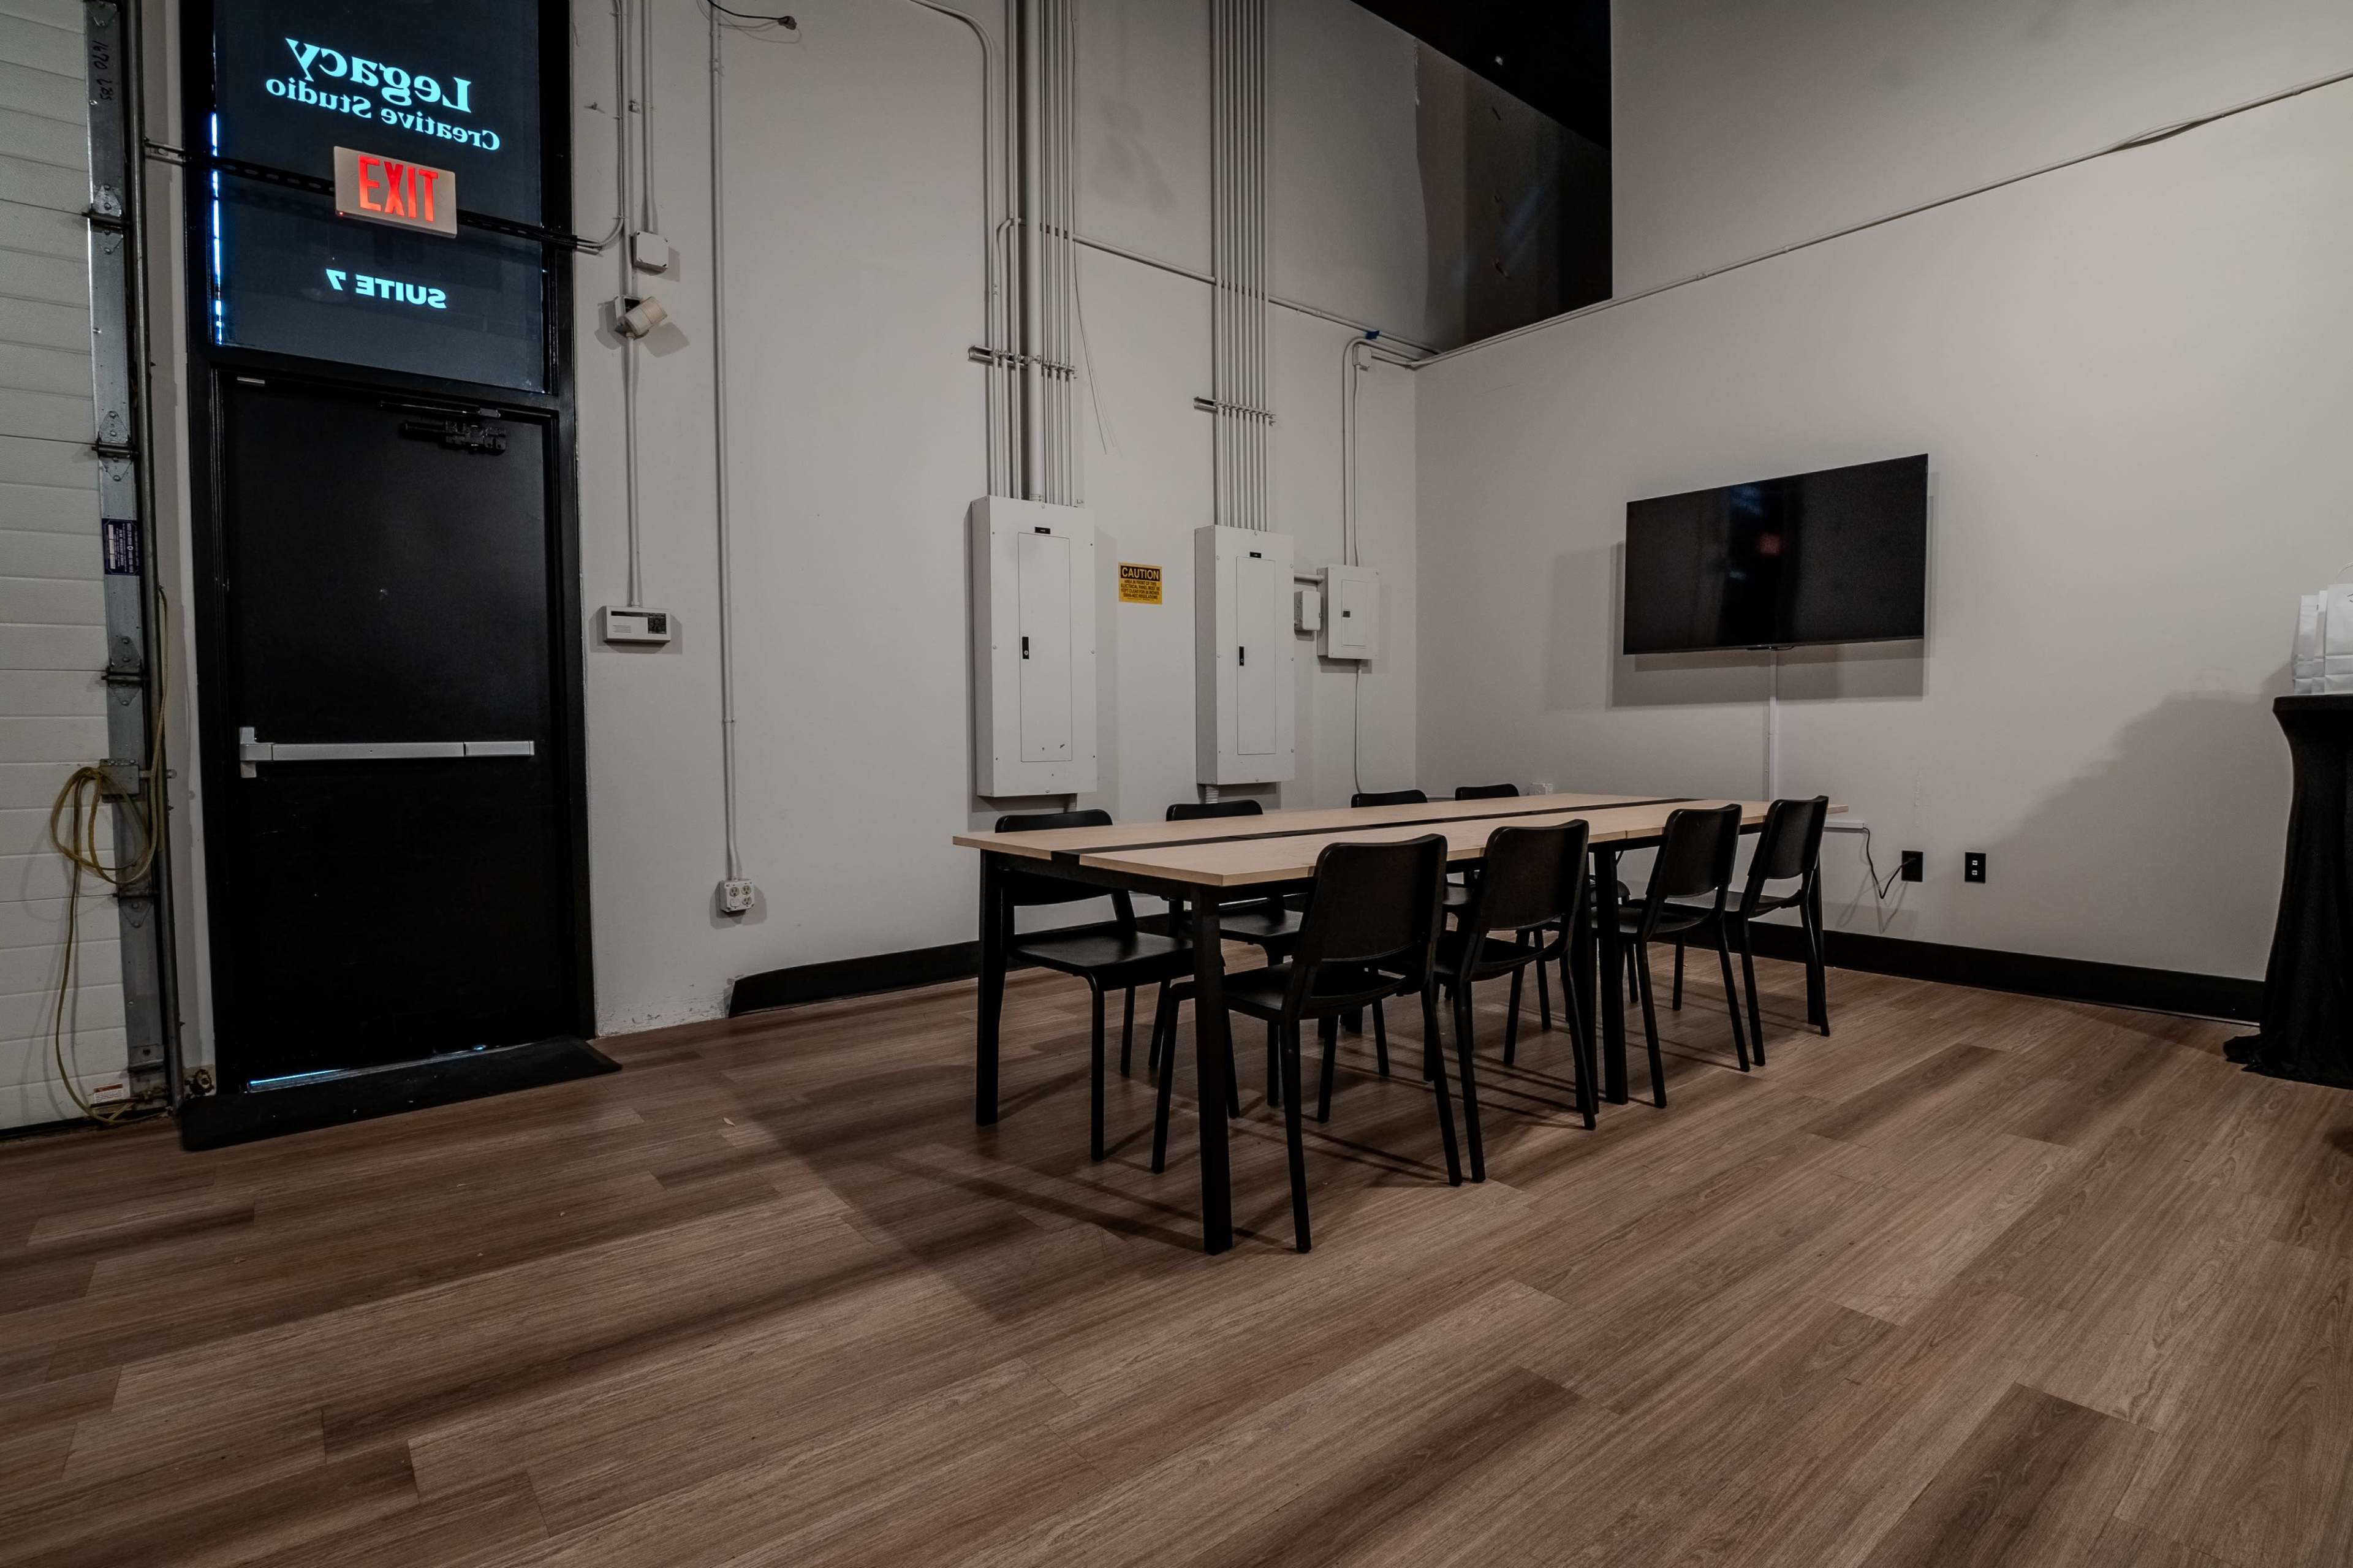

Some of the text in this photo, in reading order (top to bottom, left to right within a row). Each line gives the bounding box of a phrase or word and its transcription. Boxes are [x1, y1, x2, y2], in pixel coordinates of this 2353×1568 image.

[92, 40, 110, 70] 1670
[357, 154, 439, 223] EXIT
[1122, 567, 1159, 580] CAUTION
